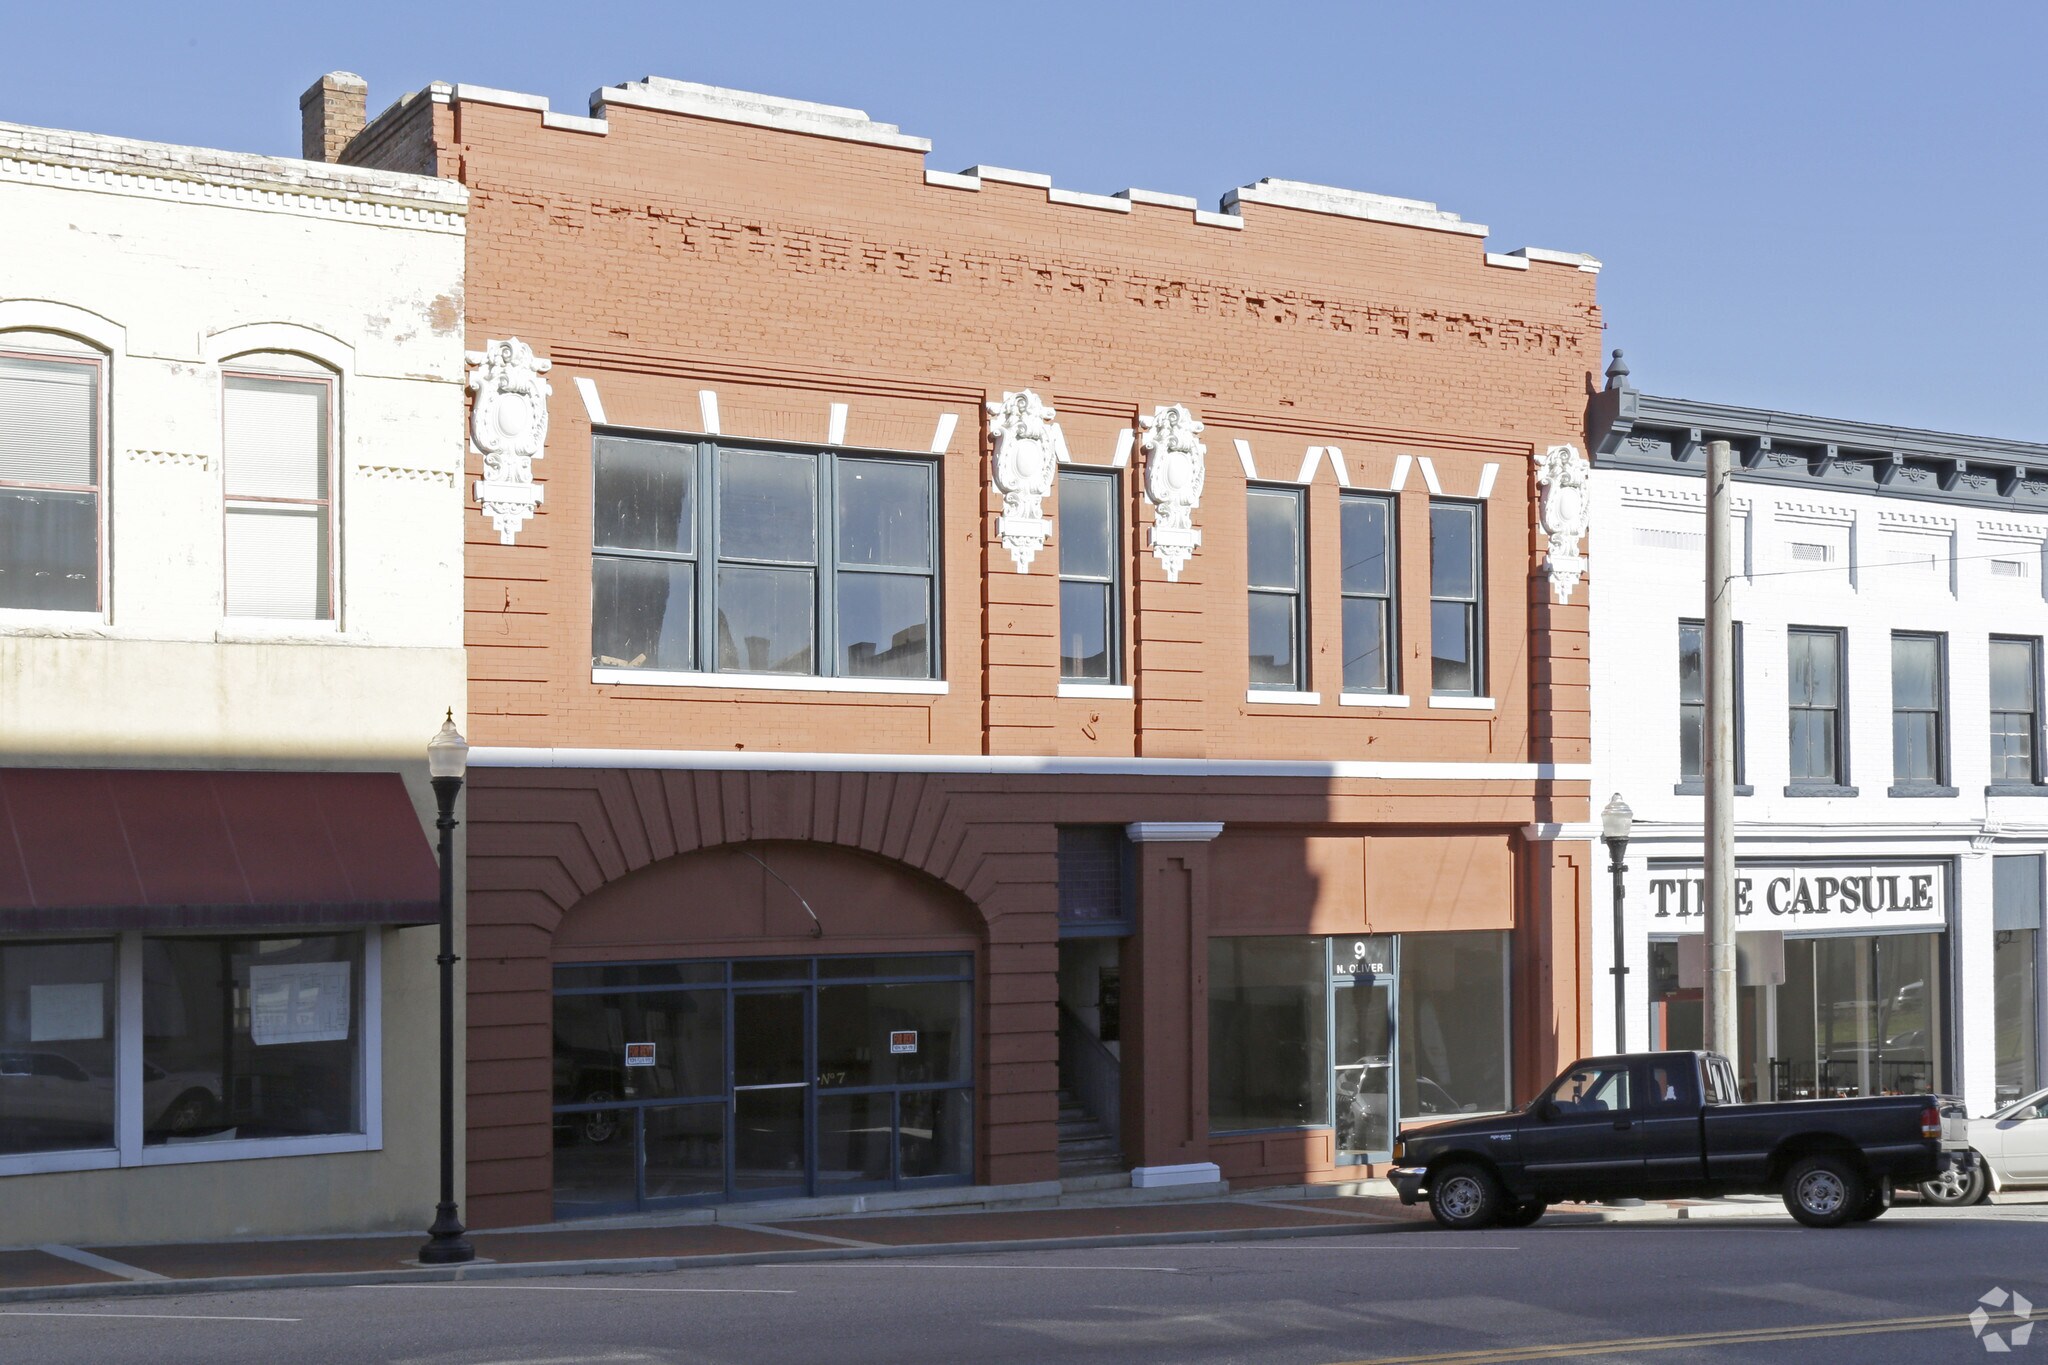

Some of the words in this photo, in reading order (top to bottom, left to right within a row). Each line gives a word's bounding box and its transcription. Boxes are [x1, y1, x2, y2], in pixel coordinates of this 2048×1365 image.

[1649, 878, 1753, 917] TIE
[1766, 874, 1933, 916] CAPSULE
[1354, 941, 1366, 960] 9
[1336, 964, 1346, 974] N.
[1349, 963, 1384, 973] OLIVER
[837, 1072, 846, 1084] 7
